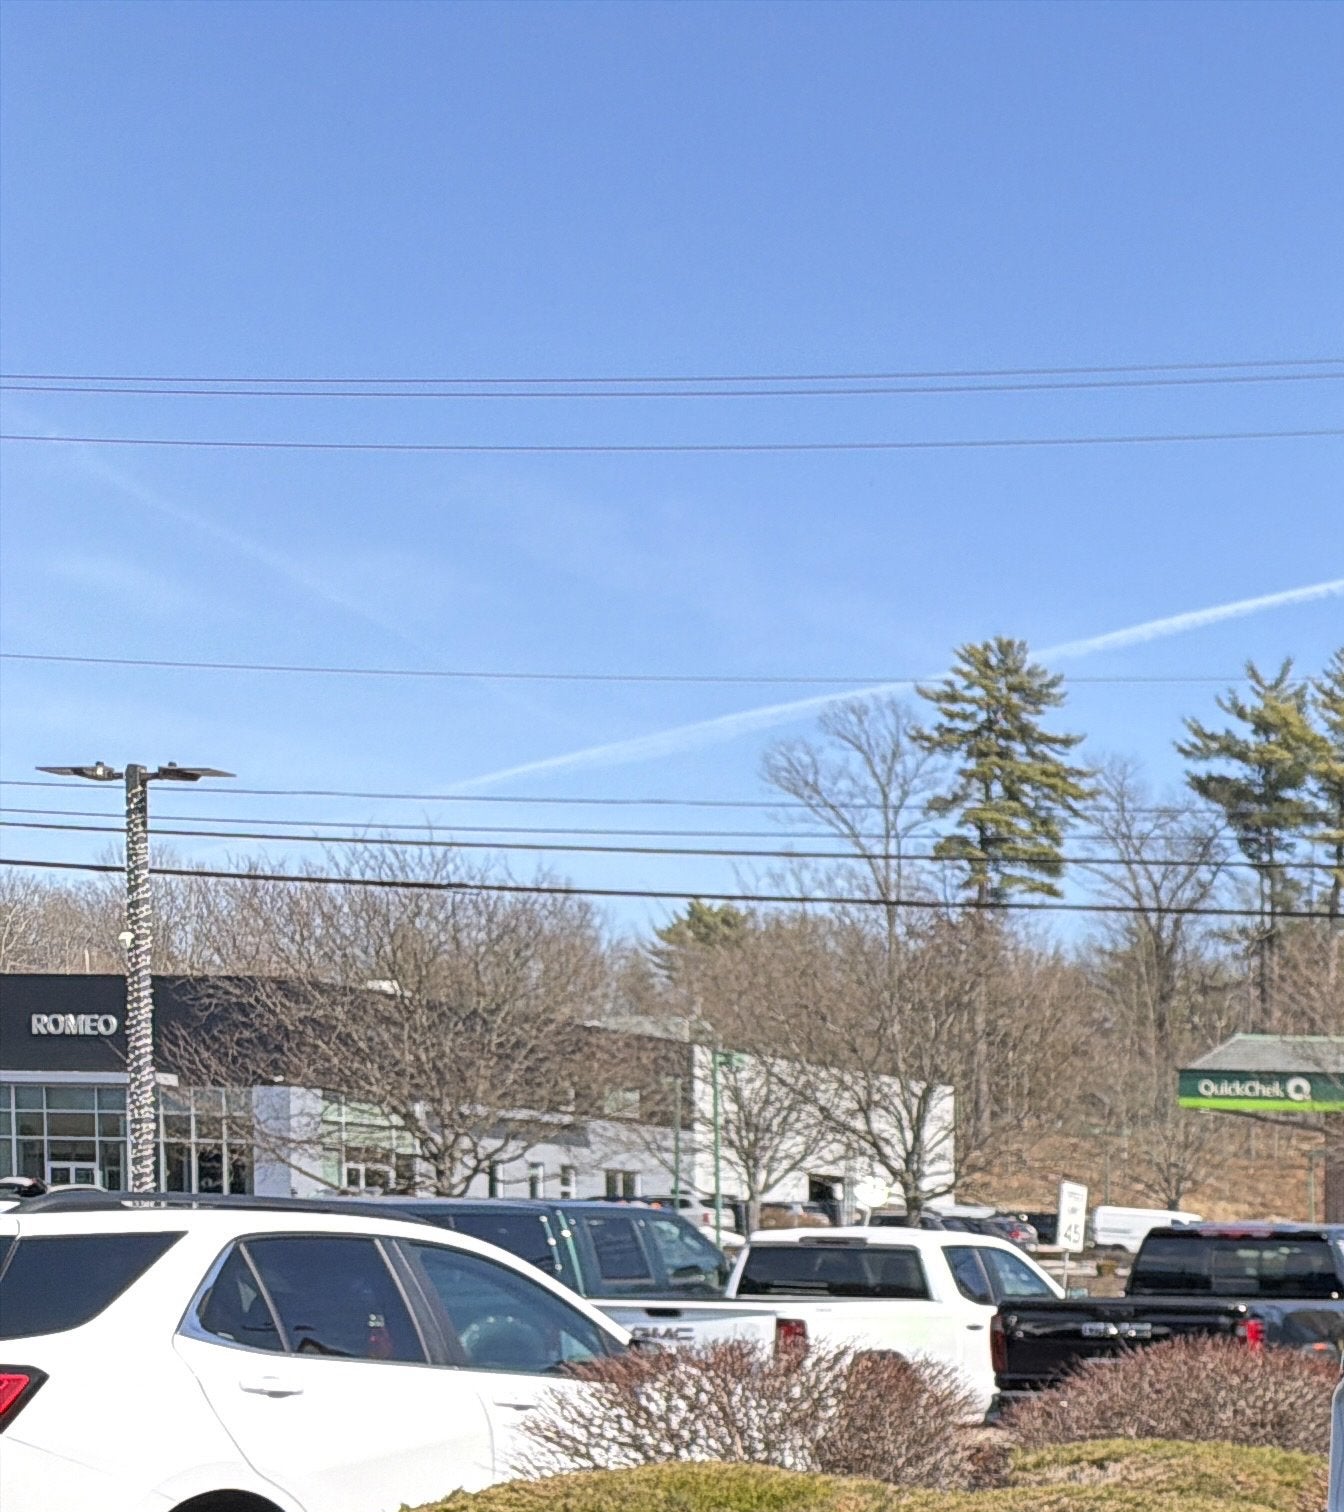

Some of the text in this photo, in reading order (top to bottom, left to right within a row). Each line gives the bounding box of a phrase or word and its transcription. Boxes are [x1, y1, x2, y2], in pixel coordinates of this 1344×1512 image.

[31, 1013, 118, 1036] ROMEO
[1198, 1078, 1285, 1098] QuickChek
[1063, 1223, 1081, 1244] 45
